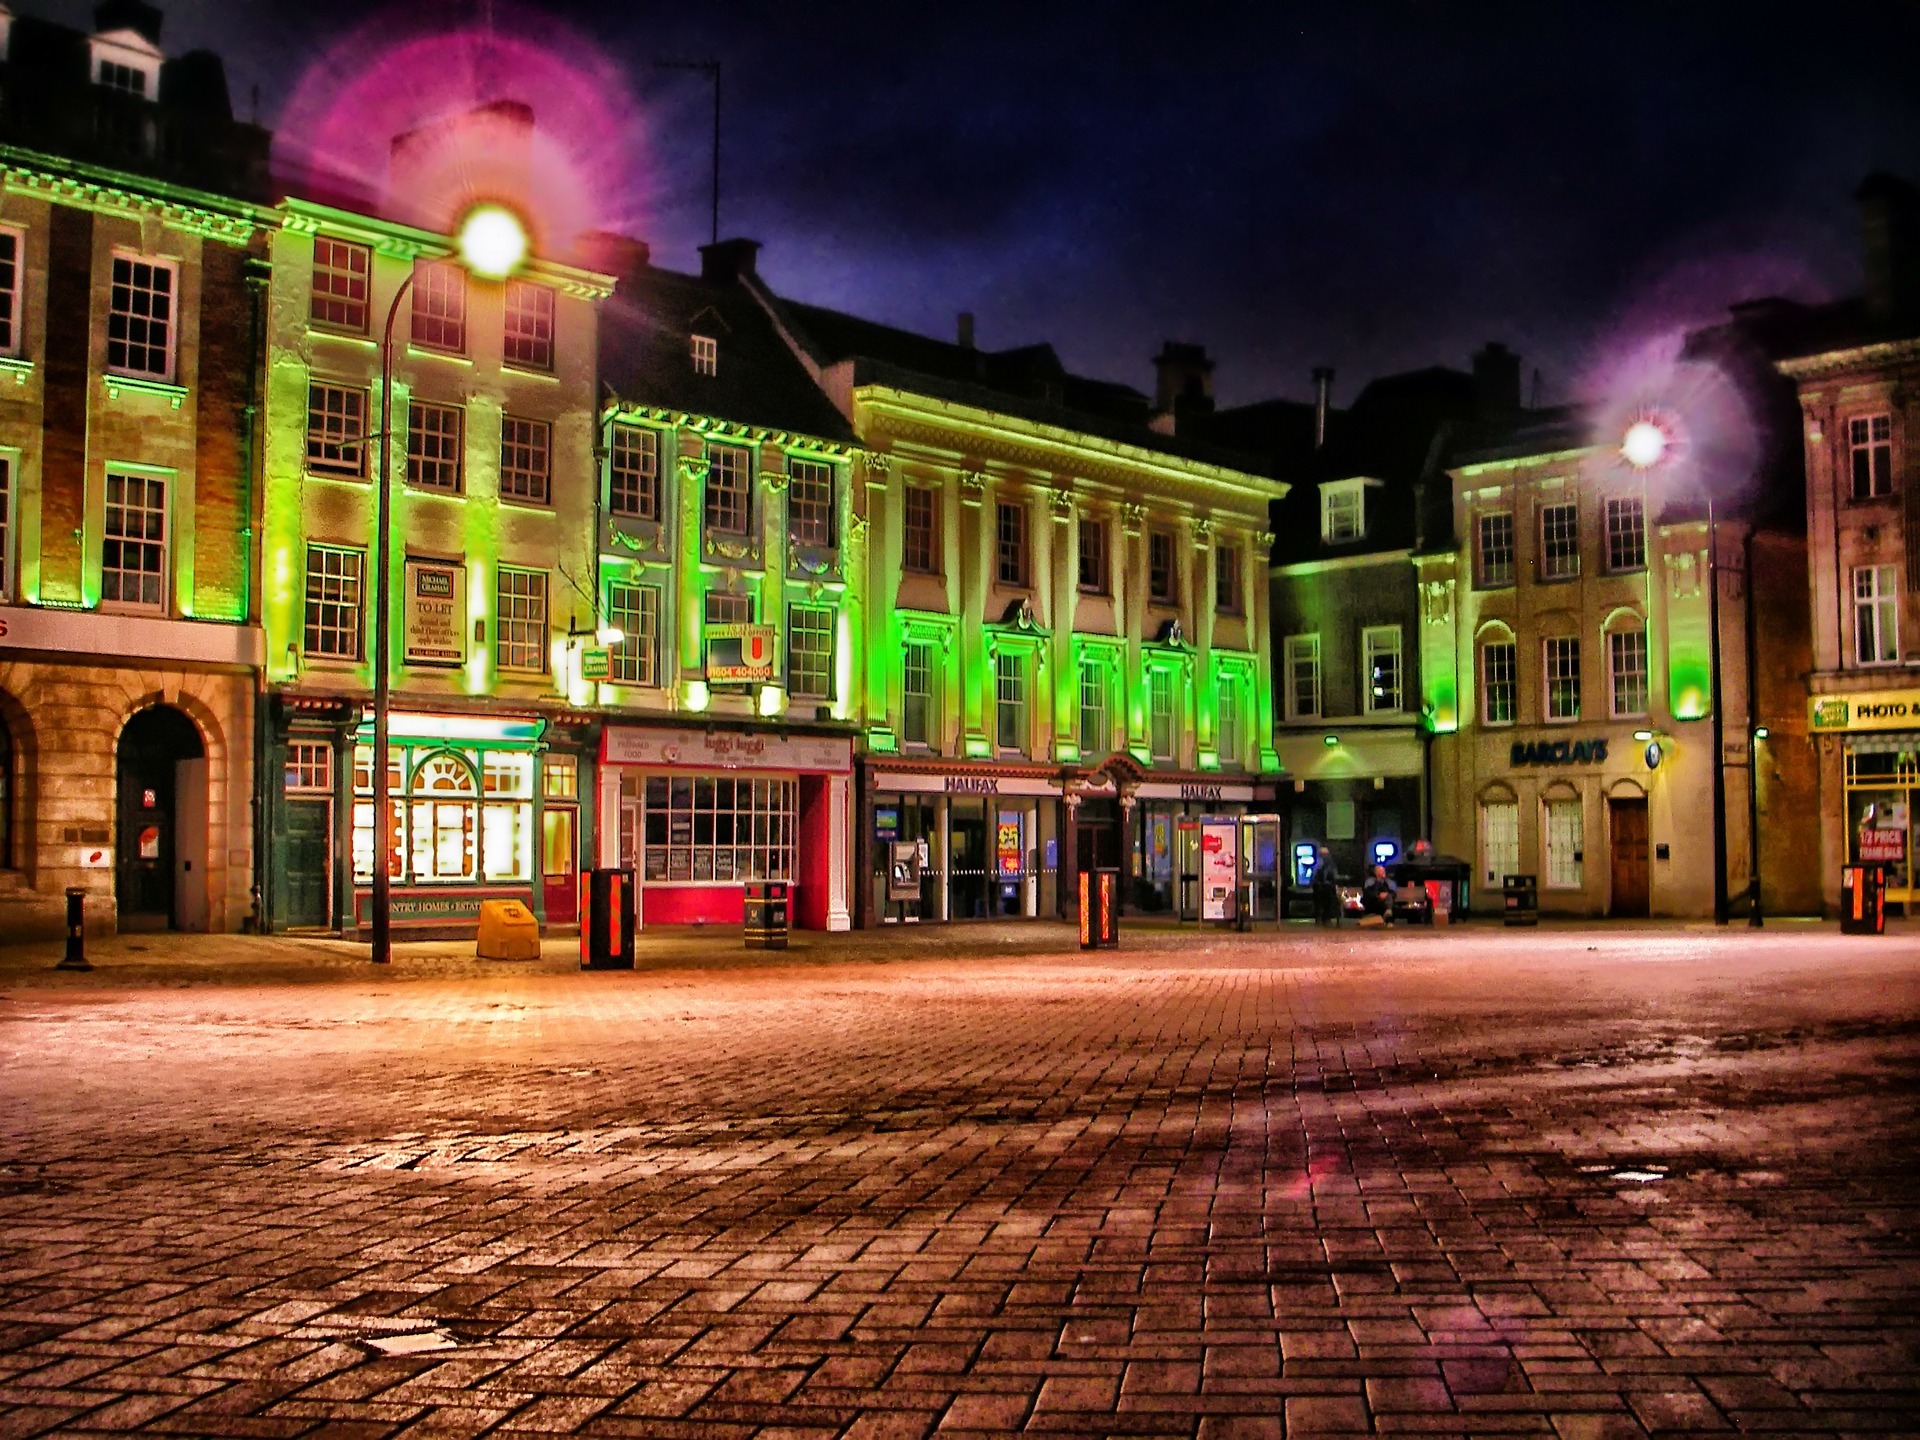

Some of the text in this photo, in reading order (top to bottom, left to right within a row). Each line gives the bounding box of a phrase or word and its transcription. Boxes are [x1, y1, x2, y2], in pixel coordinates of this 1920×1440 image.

[416, 602, 454, 616] TO LET
[706, 667, 732, 678] 01604
[1857, 703, 1908, 719] PHOTO
[1510, 738, 1609, 768] BARCLAYS
[944, 776, 998, 794] HALIFAX
[1181, 784, 1221, 799] HALIFAX
[1874, 829, 1902, 845] PRICE
[389, 900, 481, 913] NTRY HOMES ESTAT
